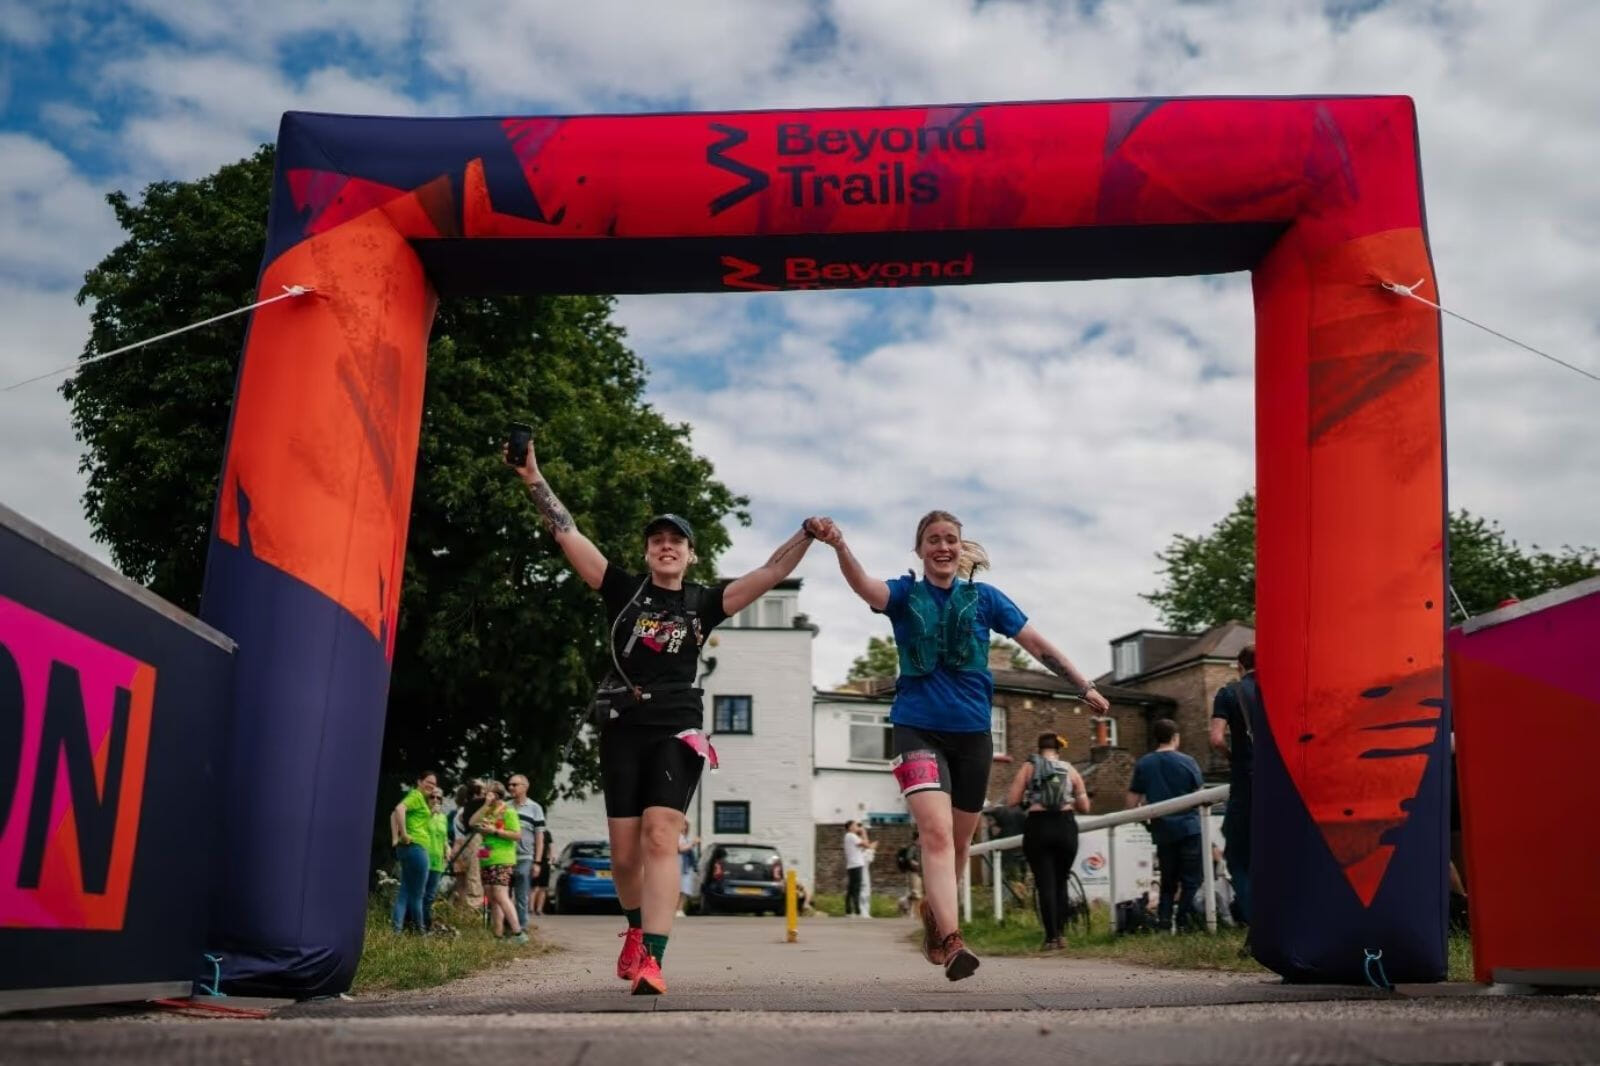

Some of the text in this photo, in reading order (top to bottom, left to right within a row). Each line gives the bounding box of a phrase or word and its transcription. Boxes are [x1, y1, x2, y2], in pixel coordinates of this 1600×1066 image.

[776, 117, 986, 162] Beyond
[777, 162, 940, 208] Trails
[785, 252, 975, 281] Beyond
